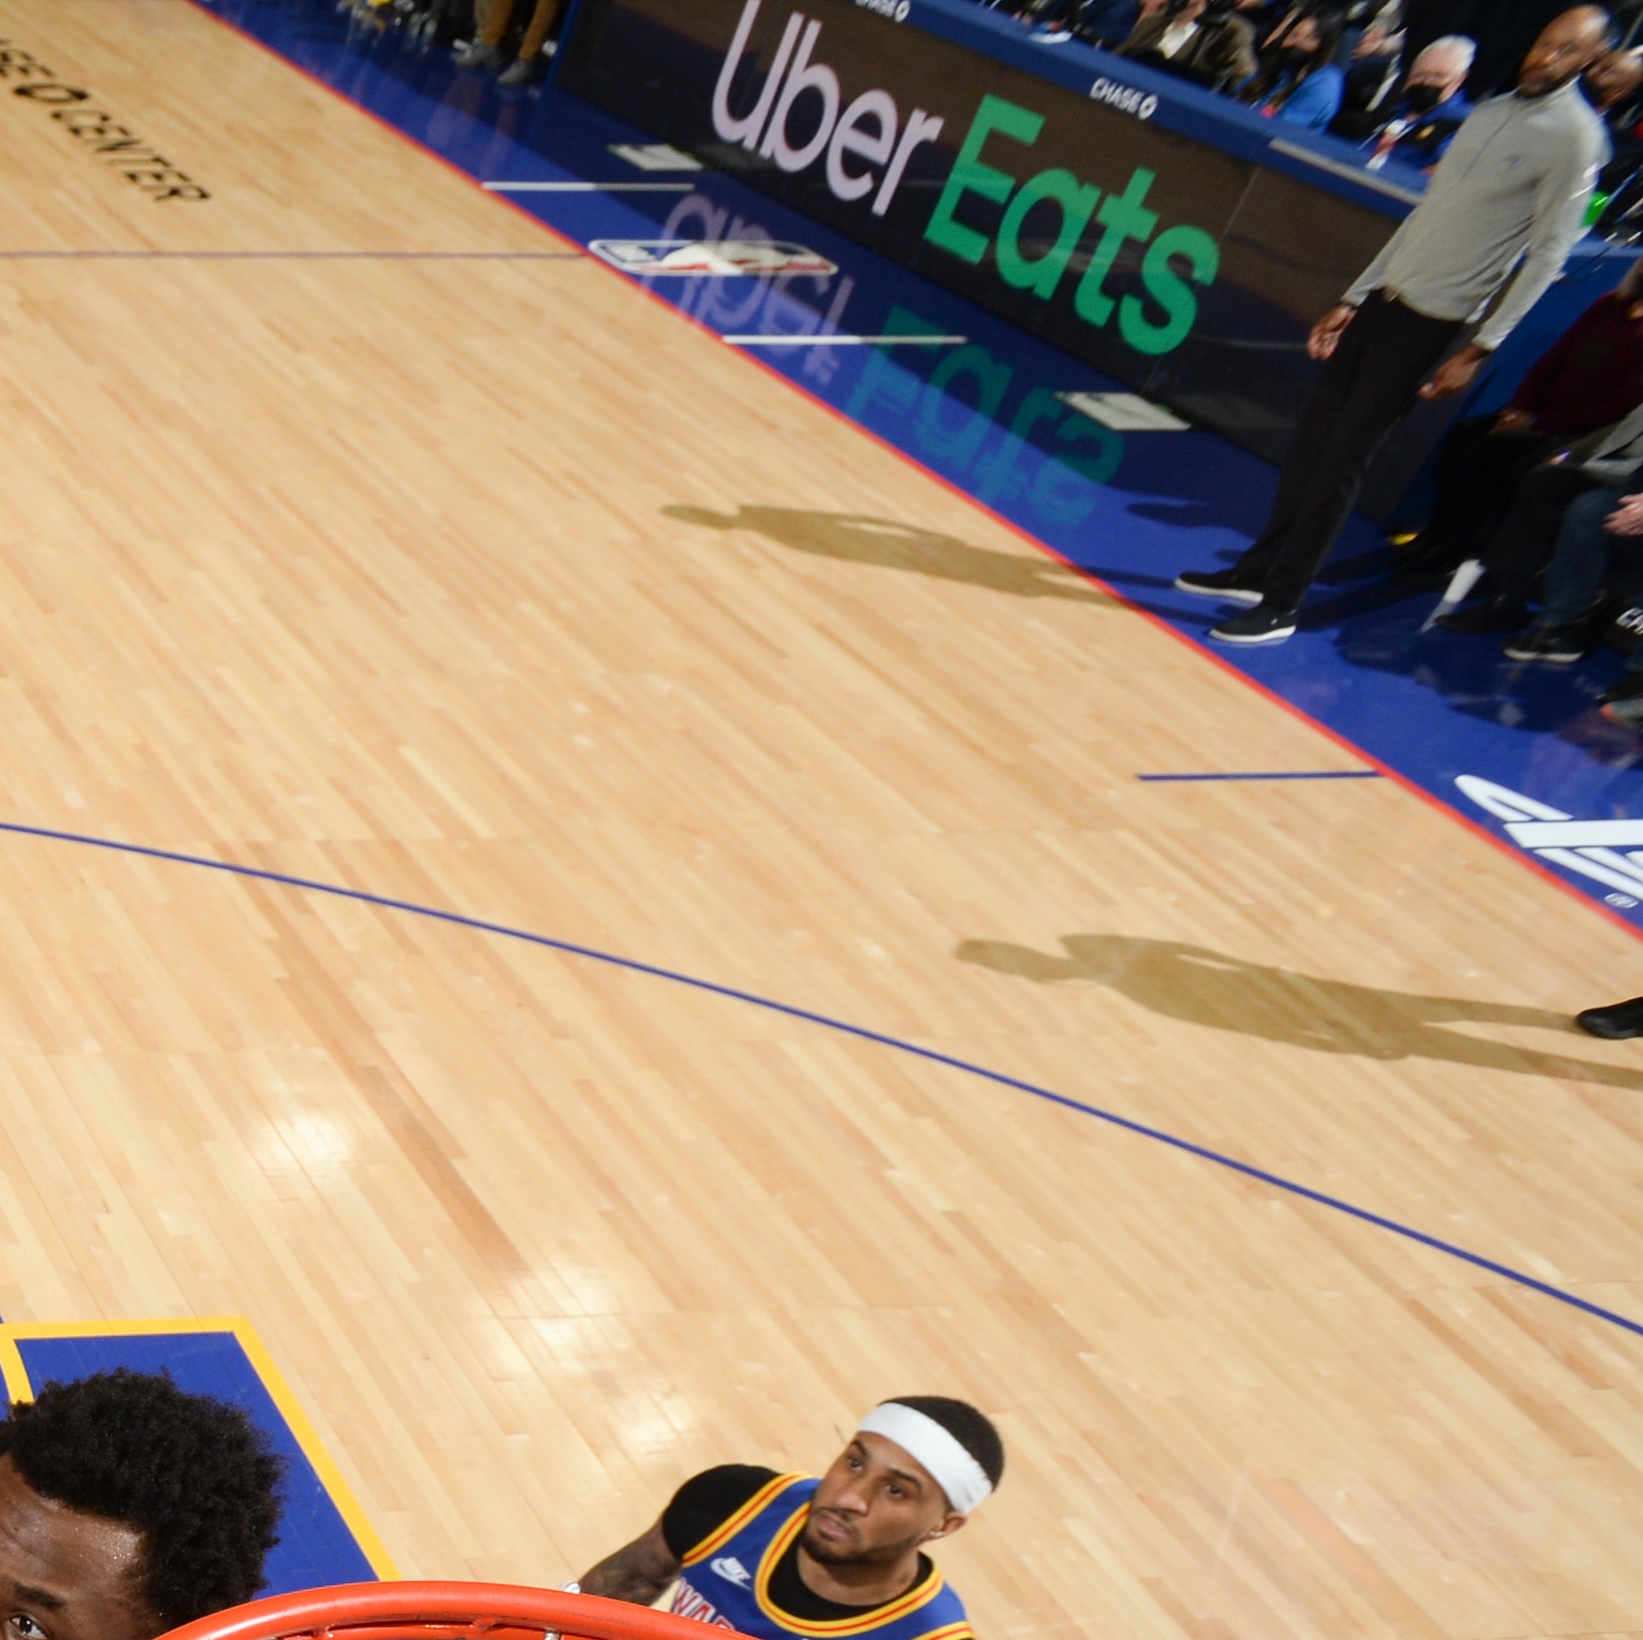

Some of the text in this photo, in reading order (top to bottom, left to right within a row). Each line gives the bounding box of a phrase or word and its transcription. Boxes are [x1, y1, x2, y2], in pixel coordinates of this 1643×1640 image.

[50, 109, 212, 203] CENTER
[712, 0, 1220, 356] Uber Eats
